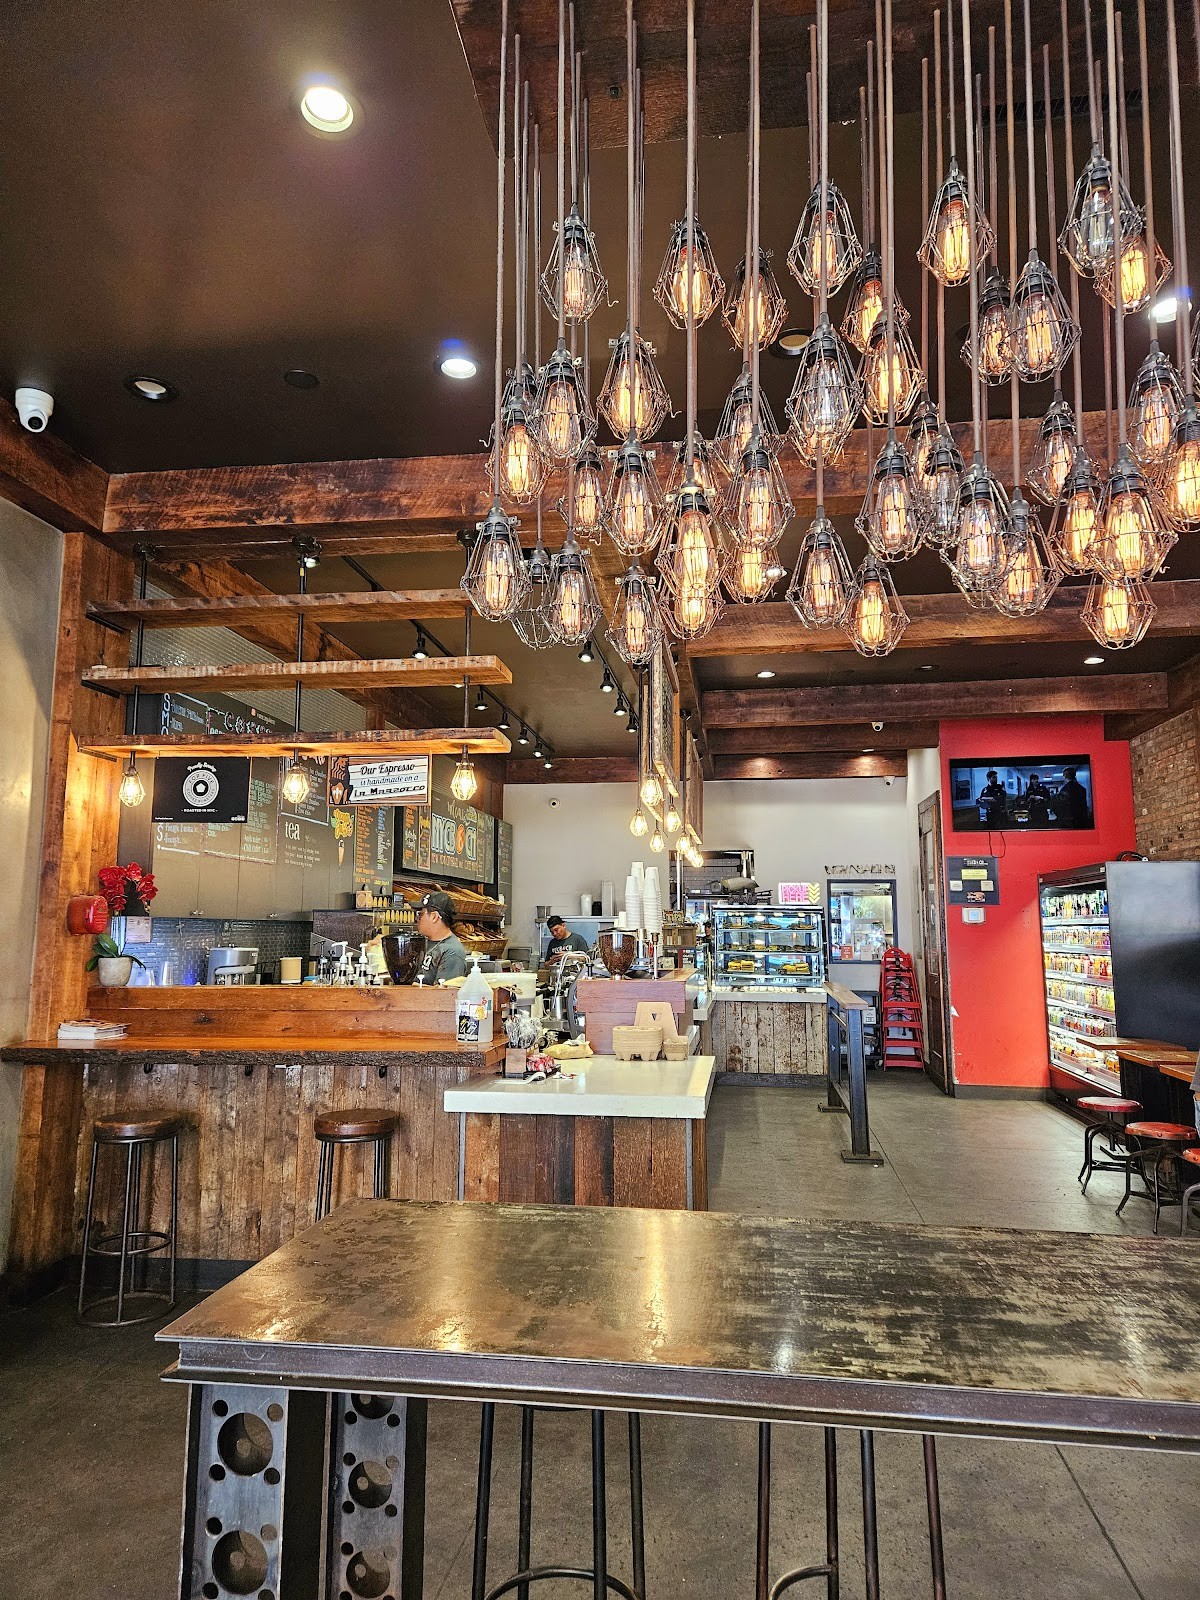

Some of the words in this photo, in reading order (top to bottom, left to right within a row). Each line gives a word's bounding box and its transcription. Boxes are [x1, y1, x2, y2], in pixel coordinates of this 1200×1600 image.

[360, 766, 377, 776] Our
[378, 763, 415, 776] Espresso
[366, 776, 403, 785] handmade
[285, 821, 300, 841] tea
[782, 892, 809, 902] HERE
